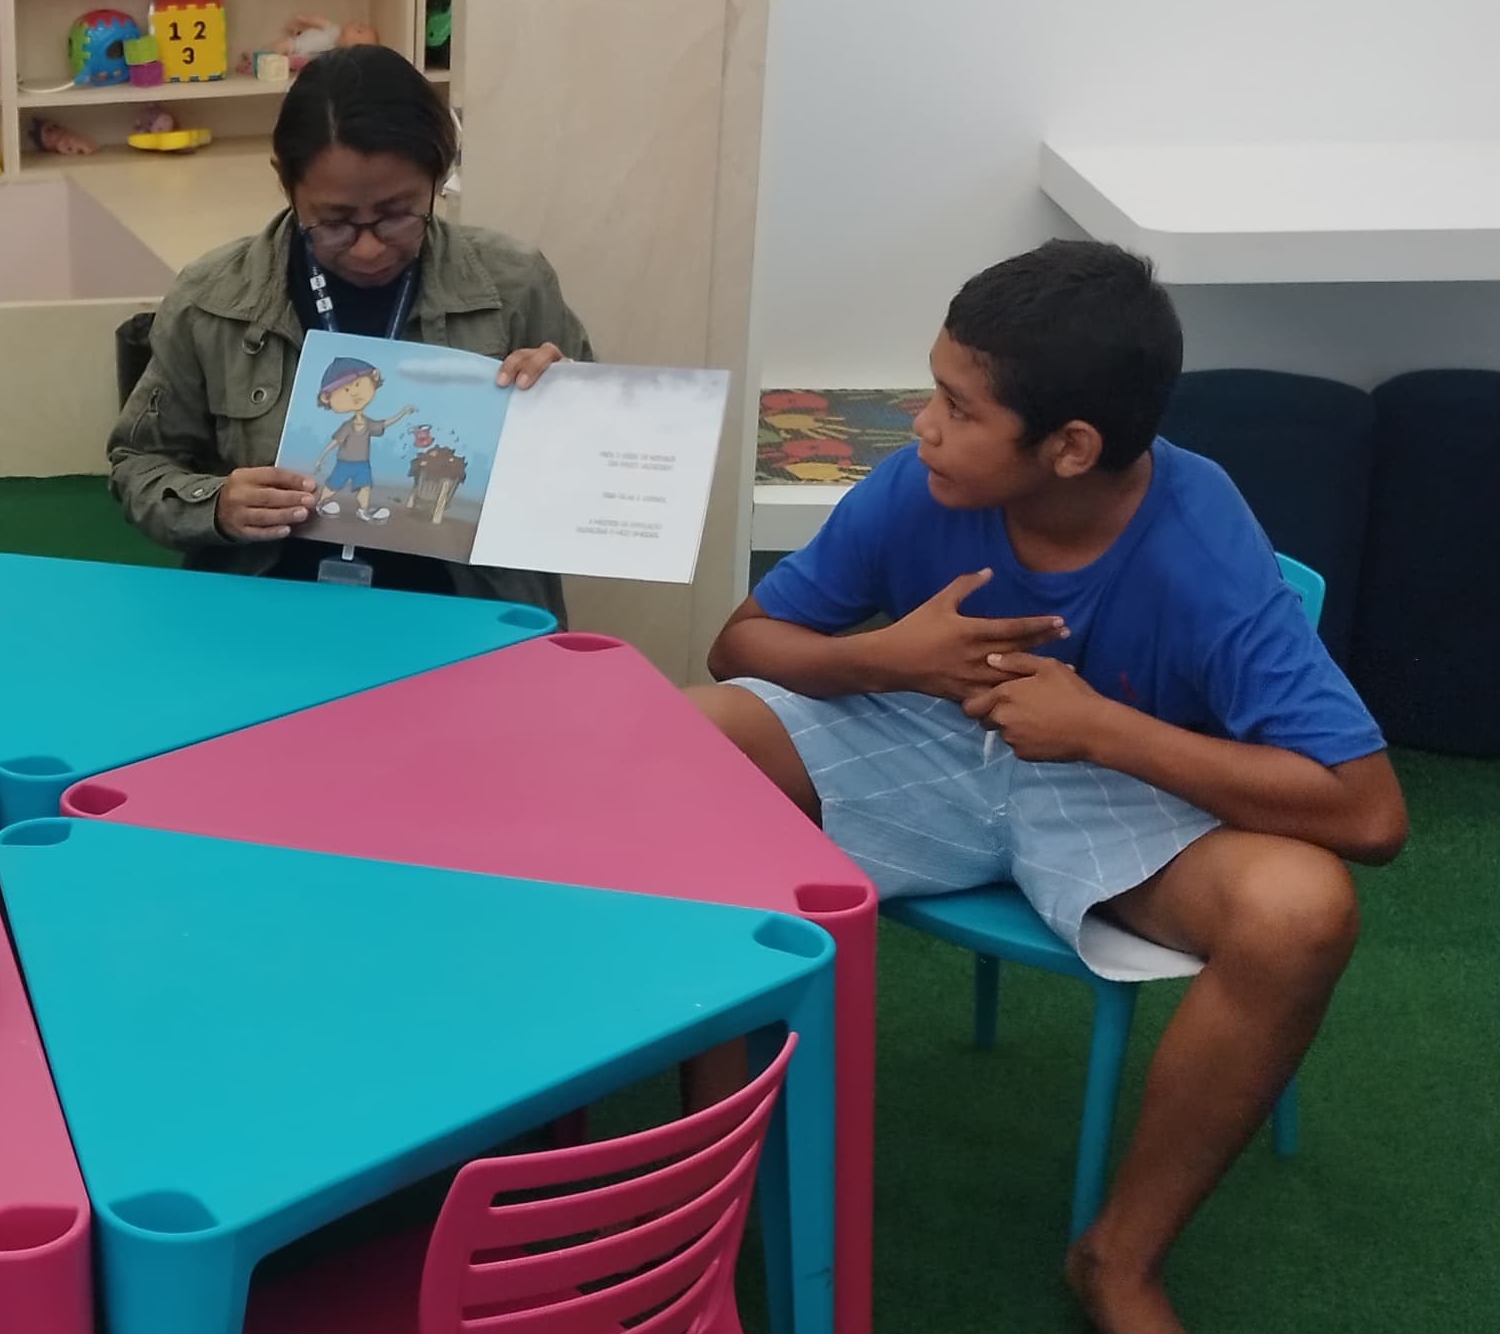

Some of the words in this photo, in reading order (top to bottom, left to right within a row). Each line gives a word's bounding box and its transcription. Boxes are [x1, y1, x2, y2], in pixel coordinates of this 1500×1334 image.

[168, 21, 182, 41] 1
[193, 20, 207, 40] 2
[181, 46, 195, 65] 3
